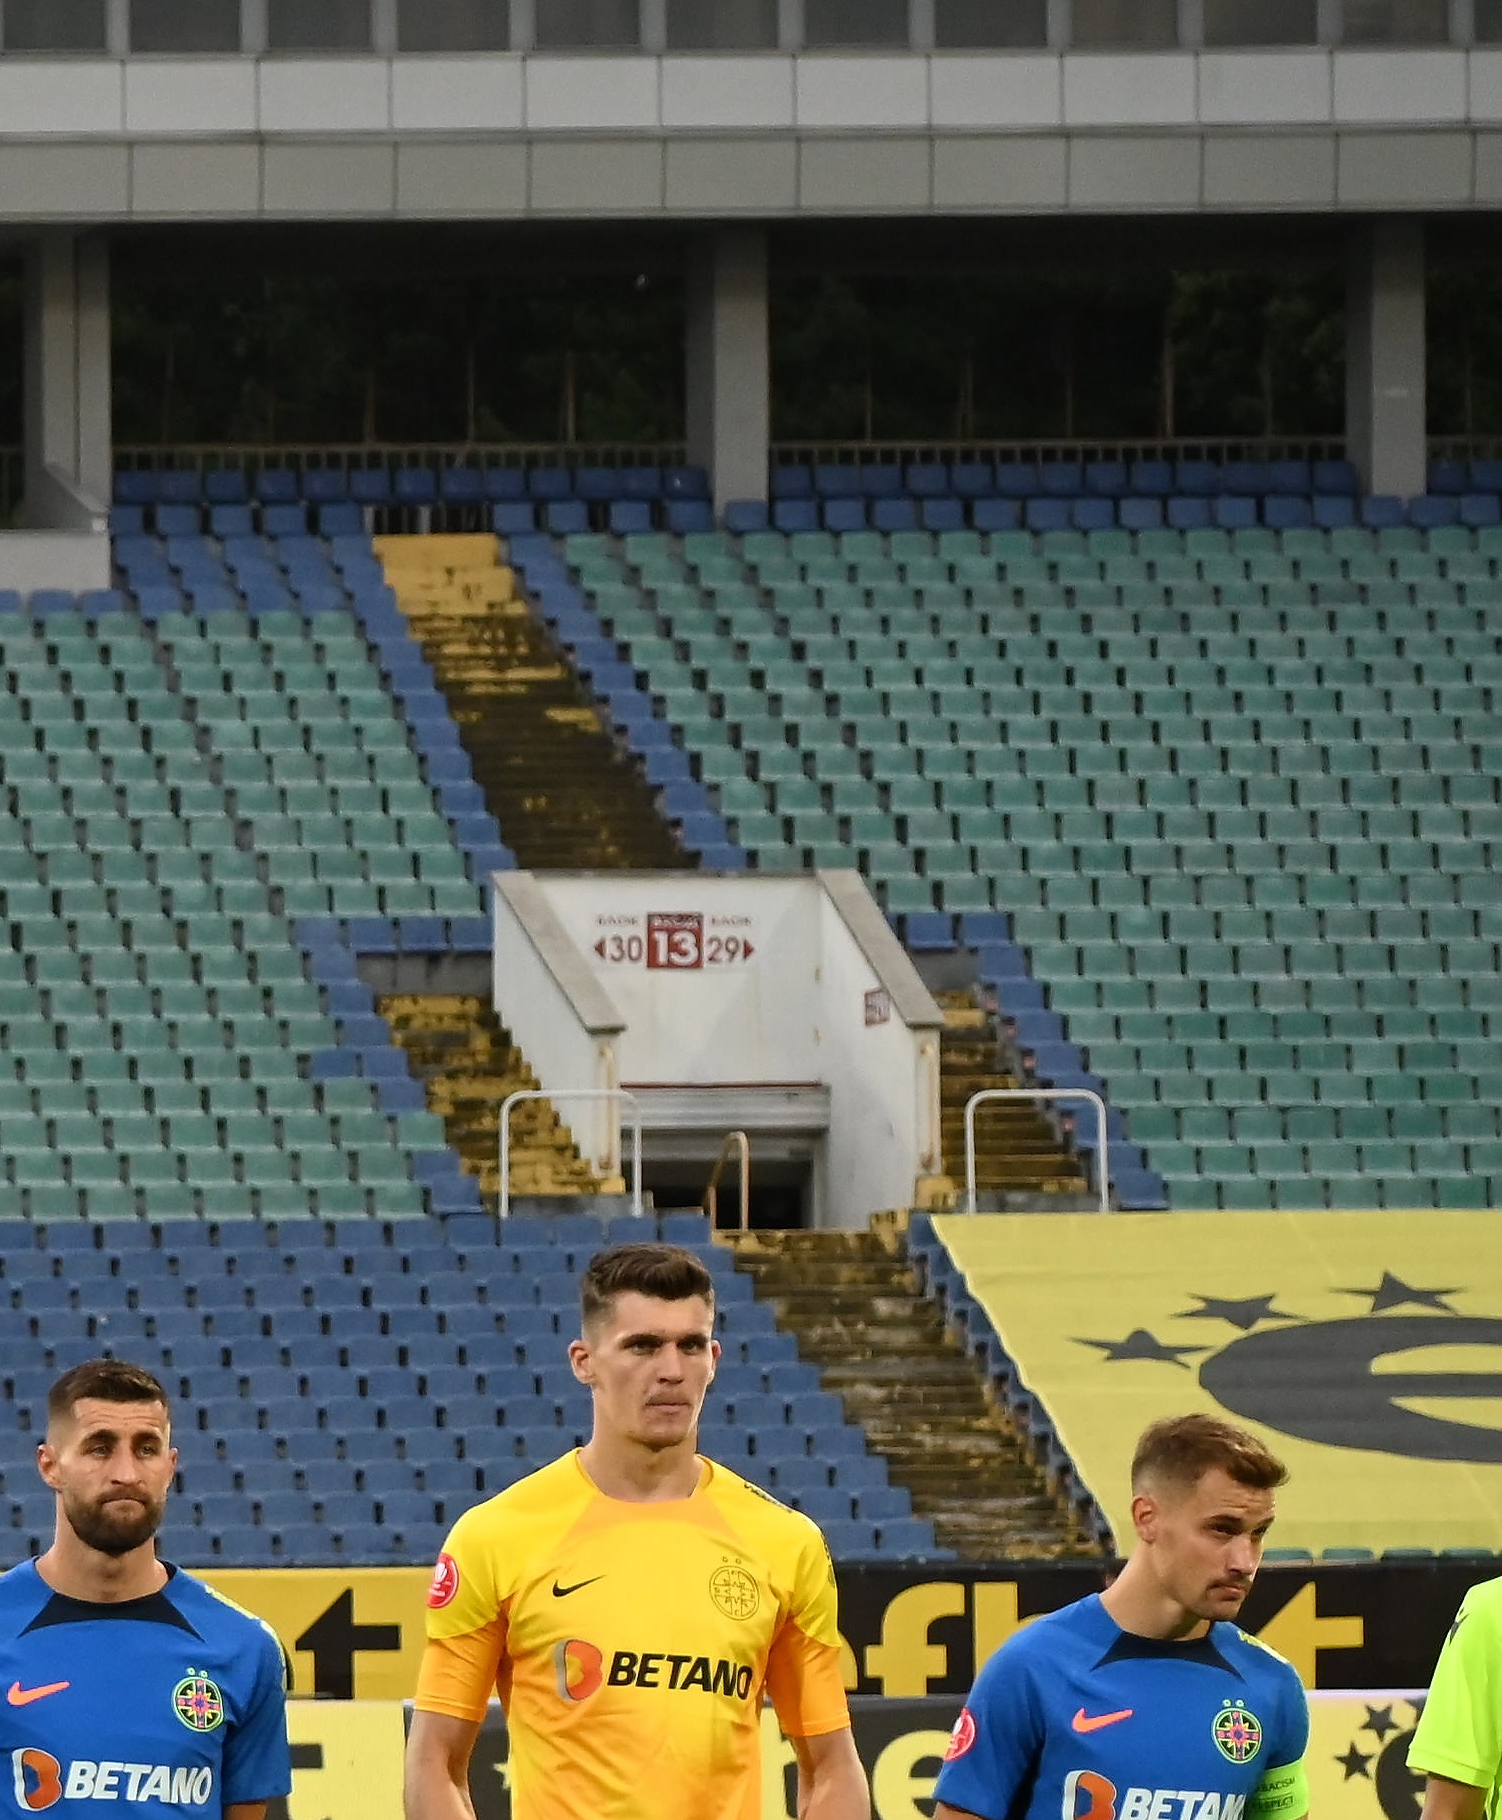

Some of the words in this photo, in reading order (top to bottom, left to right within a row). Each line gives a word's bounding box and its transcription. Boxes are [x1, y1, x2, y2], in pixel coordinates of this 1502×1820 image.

[610, 934, 643, 963] 30
[652, 929, 700, 967] 13
[706, 935, 741, 964] 29
[608, 1652, 752, 1699] BETANO
[64, 1760, 213, 1805] BETANO
